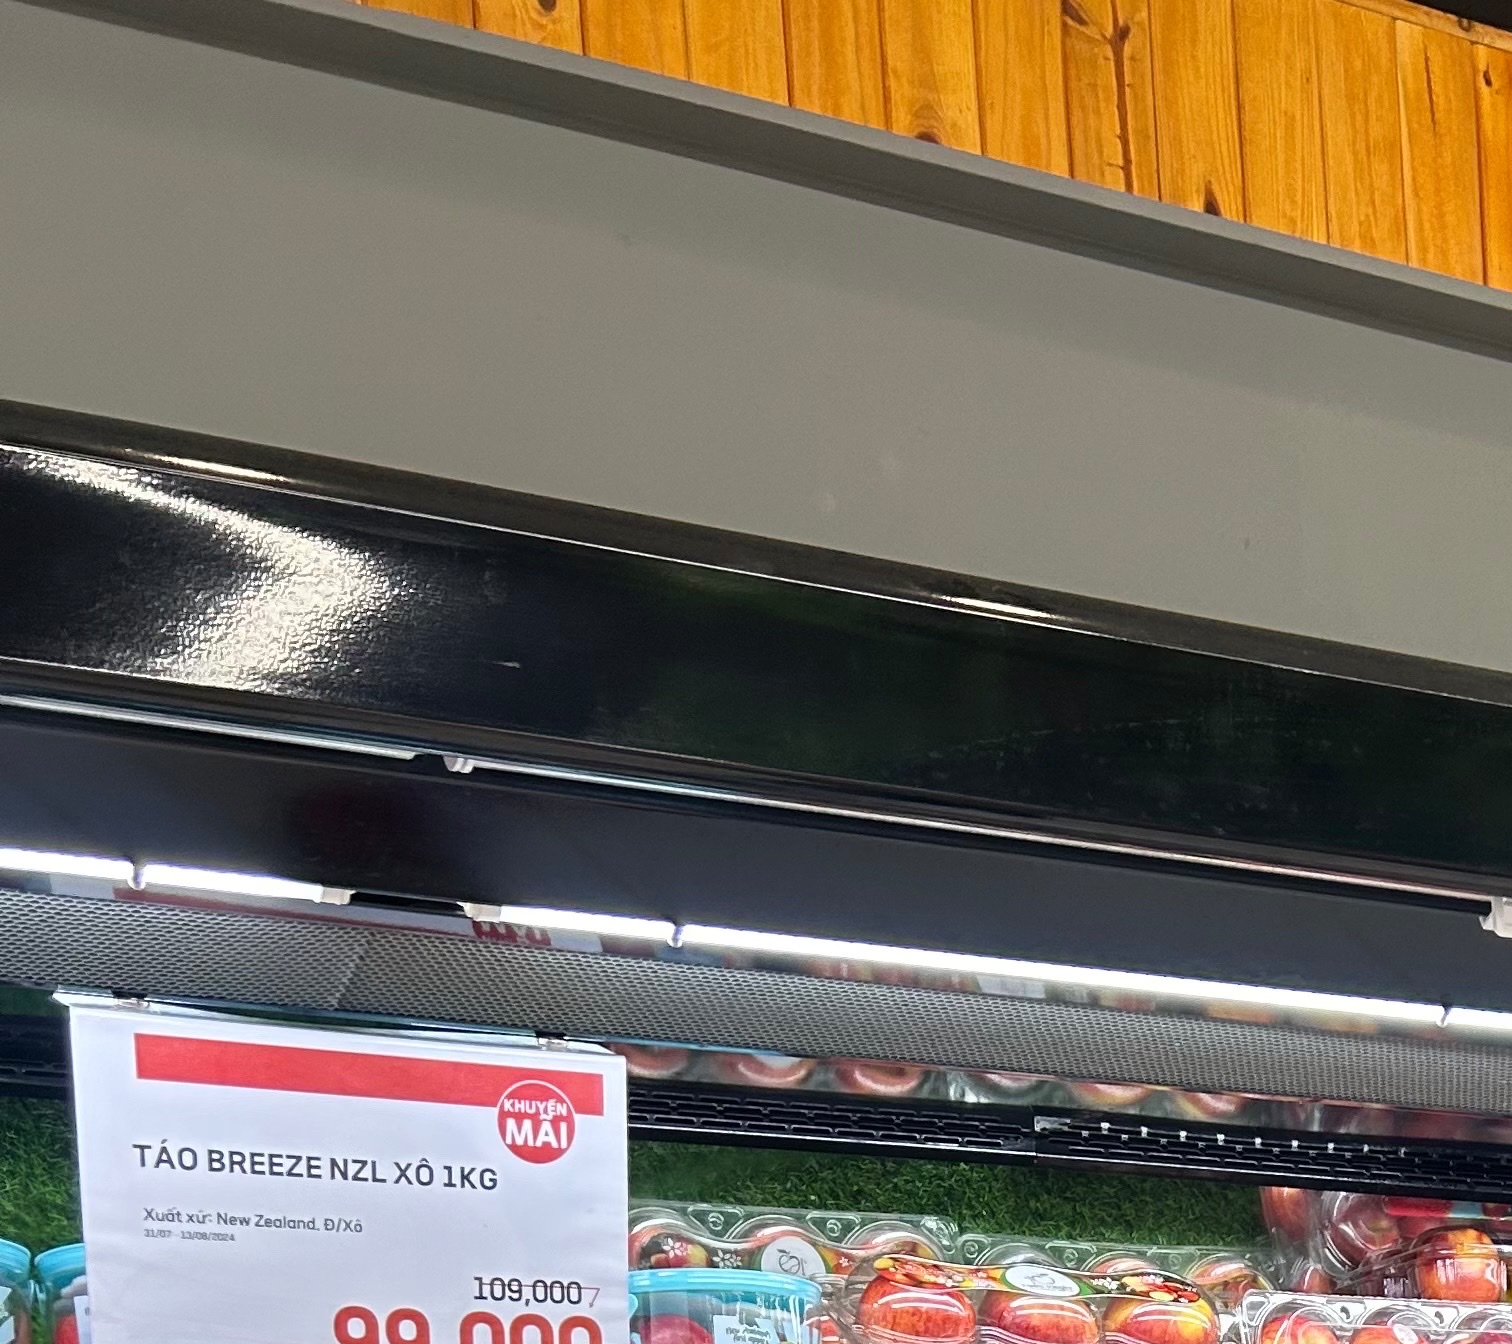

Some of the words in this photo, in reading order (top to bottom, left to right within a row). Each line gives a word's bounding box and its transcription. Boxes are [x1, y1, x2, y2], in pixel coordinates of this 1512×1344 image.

[504, 1098, 567, 1117] KHUYẾN
[506, 1113, 568, 1149] MÃI
[132, 1138, 198, 1171] TÁO
[207, 1149, 323, 1180] BREEZE
[330, 1157, 387, 1184] NZL
[393, 1157, 435, 1187] XÔ
[443, 1165, 498, 1191] 1KG
[217, 1212, 251, 1227] New
[473, 1276, 582, 1307] 109,000
